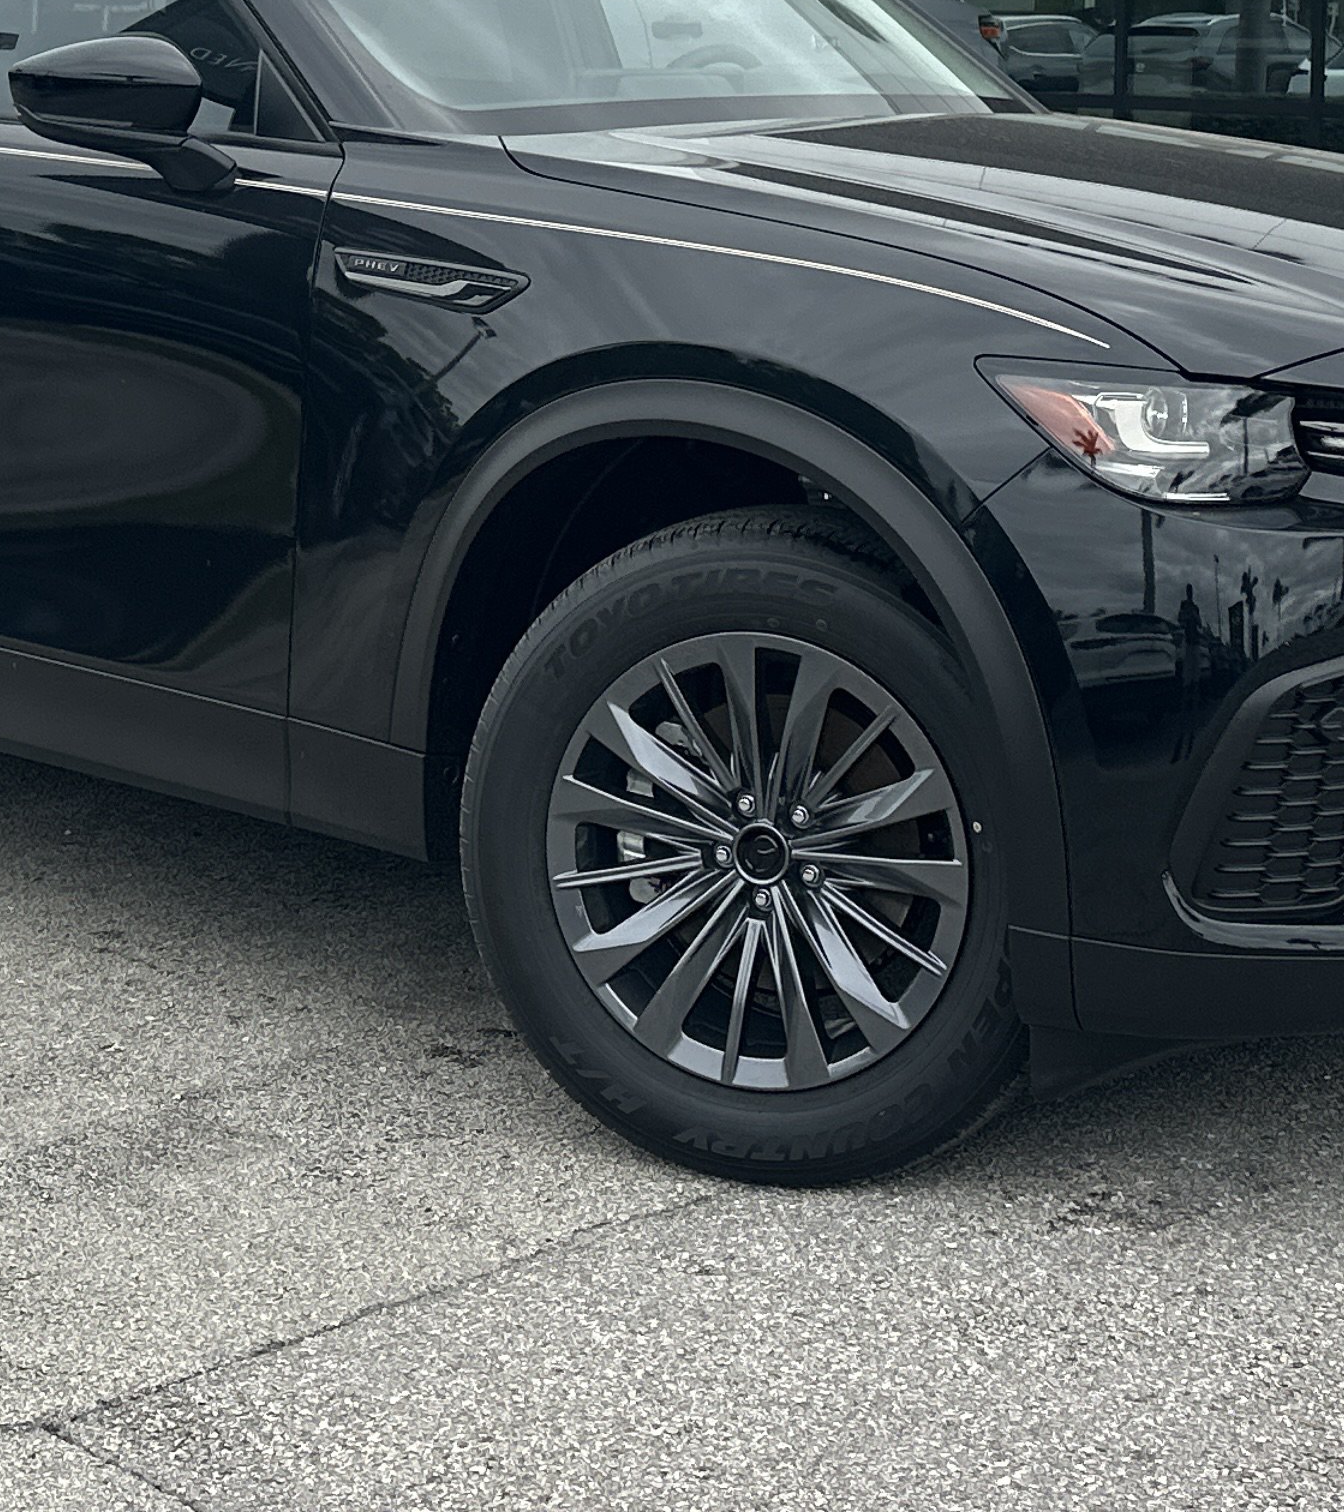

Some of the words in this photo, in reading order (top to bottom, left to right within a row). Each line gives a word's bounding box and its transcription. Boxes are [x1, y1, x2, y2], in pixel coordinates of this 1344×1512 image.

[353, 257, 399, 273] PHEV
[543, 582, 663, 679] TOYO
[947, 954, 1013, 1073] PEN
[548, 1035, 645, 1115] H/T
[672, 1081, 933, 1162] COUNTRY
